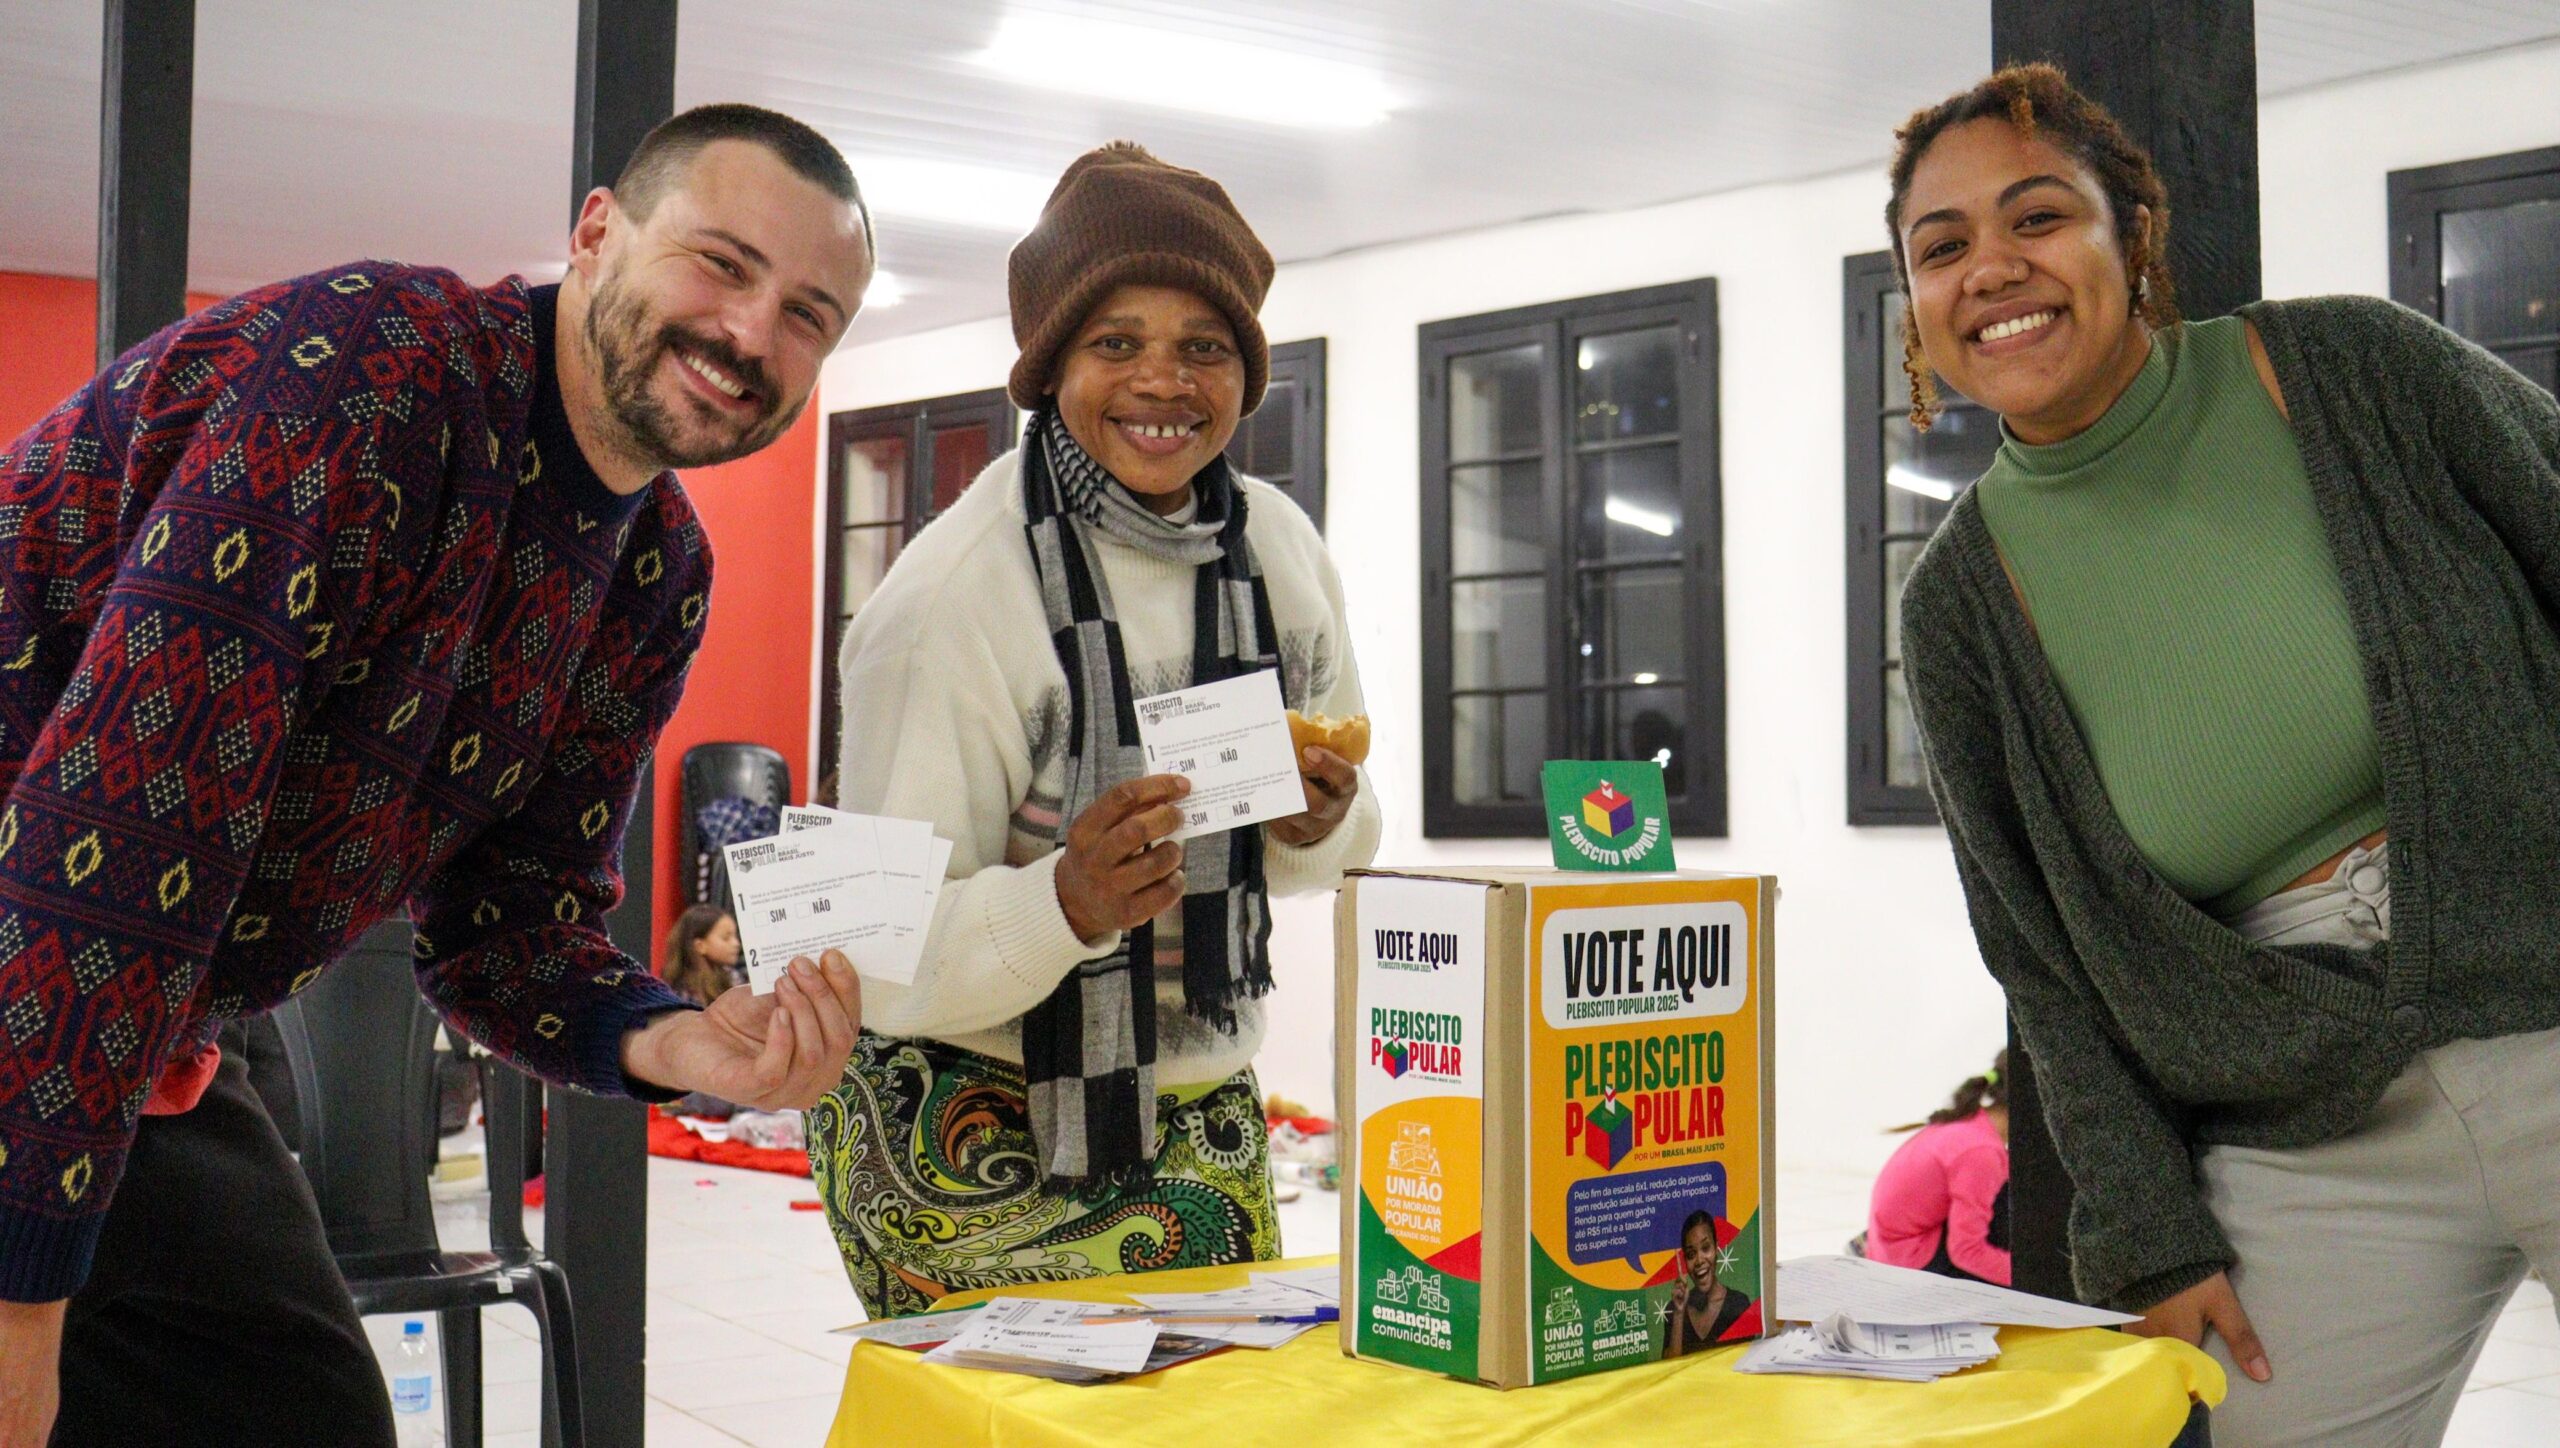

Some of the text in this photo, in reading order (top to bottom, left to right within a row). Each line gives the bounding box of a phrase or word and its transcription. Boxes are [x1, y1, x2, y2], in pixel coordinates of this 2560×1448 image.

[1140, 696, 1182, 714] PLEBISCITO
[1142, 706, 1184, 724] PPULAR
[1148, 745, 1155, 762] 1
[1180, 748, 1238, 772] SIM NÃO
[1192, 802, 1250, 826] SIM NÃO
[731, 843, 775, 861] PLEBISCITO
[1560, 815, 1660, 866] PLEBISCITO POPULAR
[733, 854, 777, 872] PPULAR
[738, 894, 745, 911] 1
[770, 898, 830, 923] SIM NÃO
[750, 949, 759, 967] 2
[1375, 929, 1458, 970] VOTE AQUI
[1563, 924, 1730, 1003] VOTE AQUI
[1566, 994, 1679, 1020] PLEBISCITO POPULAR 2025
[1372, 1008, 1462, 1045] PLEBISCITO
[1372, 1037, 1462, 1076] PPULAR
[1566, 1030, 1724, 1099] PLEBISCITO
[1566, 1086, 1724, 1156] PPULAR
[1634, 1152, 1648, 1161] POR
[1662, 1148, 1685, 1158] BRASIL
[1686, 1145, 1702, 1154] MAIS
[1704, 1142, 1724, 1152] JUSTO
[1386, 1176, 1442, 1202] UNIÃO
[1574, 1191, 1590, 1200] Pelo
[1591, 1188, 1601, 1198] fim
[1603, 1187, 1611, 1196] da
[1613, 1184, 1634, 1194] escala
[1650, 1178, 1677, 1189] redução
[1678, 1176, 1686, 1185] da
[1687, 1172, 1712, 1186] jornada
[1386, 1198, 1441, 1216] POR MORADIA
[1574, 1204, 1589, 1214] sem
[1590, 1199, 1618, 1211] redução
[1645, 1190, 1671, 1202] isenção
[1672, 1188, 1680, 1198] do
[1682, 1186, 1709, 1198] Imposto
[1710, 1184, 1718, 1193] de
[1386, 1210, 1441, 1234] POPULAR
[1575, 1206, 1656, 1226] Renda para quem ganha
[1575, 1228, 1586, 1239] até
[1587, 1226, 1600, 1237] R$5
[1602, 1224, 1612, 1234] mil
[1625, 1219, 1651, 1231] taxação
[1575, 1242, 1588, 1252] dos
[1372, 1322, 1452, 1350] comunidades
[1544, 1322, 1584, 1342] UNIÃO
[1546, 1347, 1584, 1364] POPULAR
[1593, 1343, 1649, 1362] comunidades
